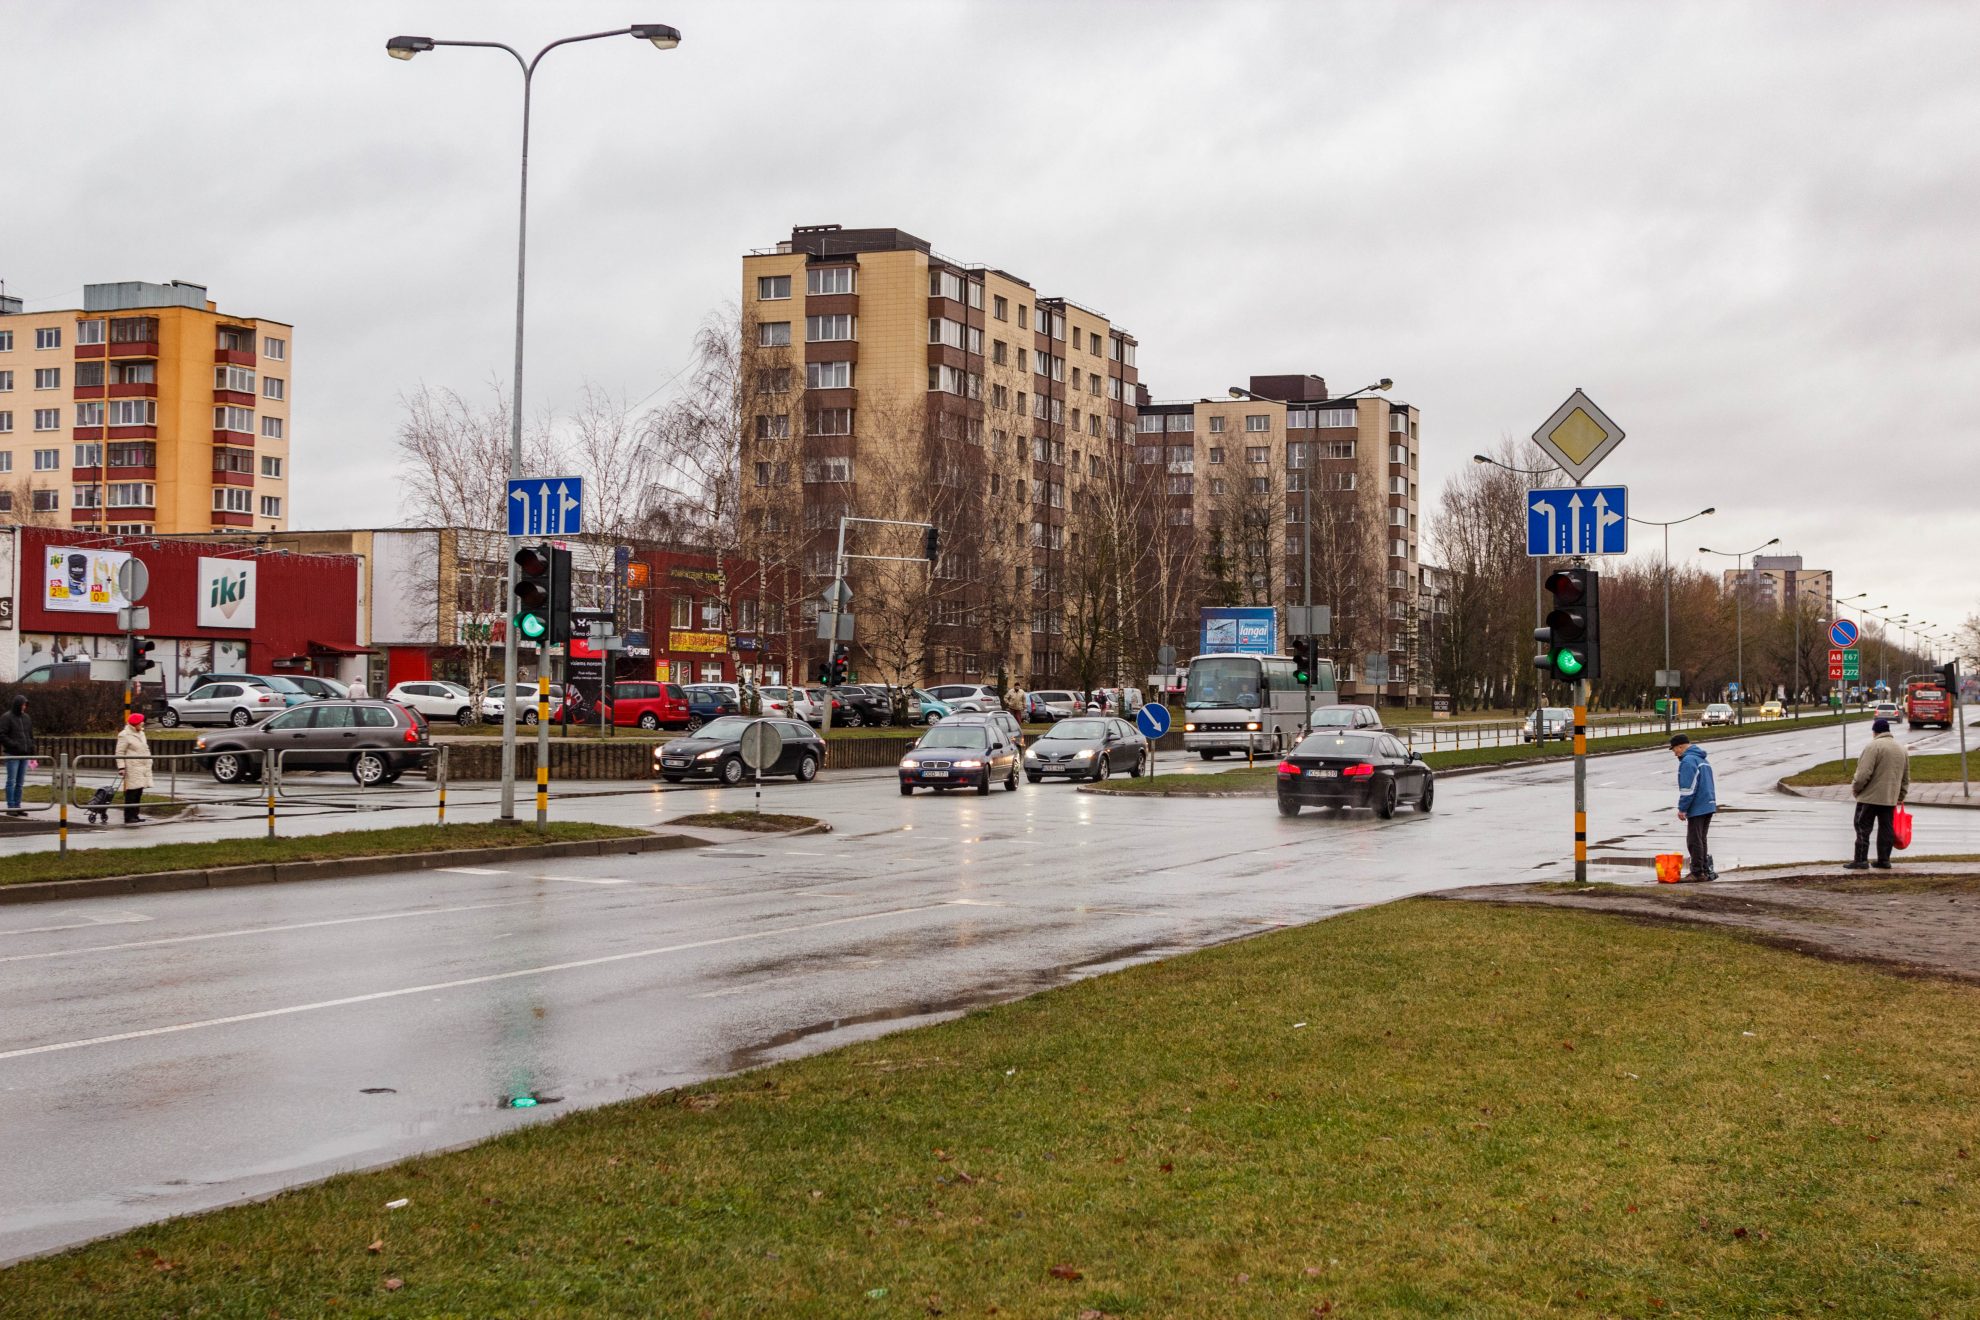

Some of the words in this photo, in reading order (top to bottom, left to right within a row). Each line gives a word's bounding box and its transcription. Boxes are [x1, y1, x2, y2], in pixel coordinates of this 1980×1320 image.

[211, 571, 247, 608] iki
[1240, 625, 1269, 639] langai
[1831, 653, 1842, 661] A8
[1843, 653, 1858, 661] E67
